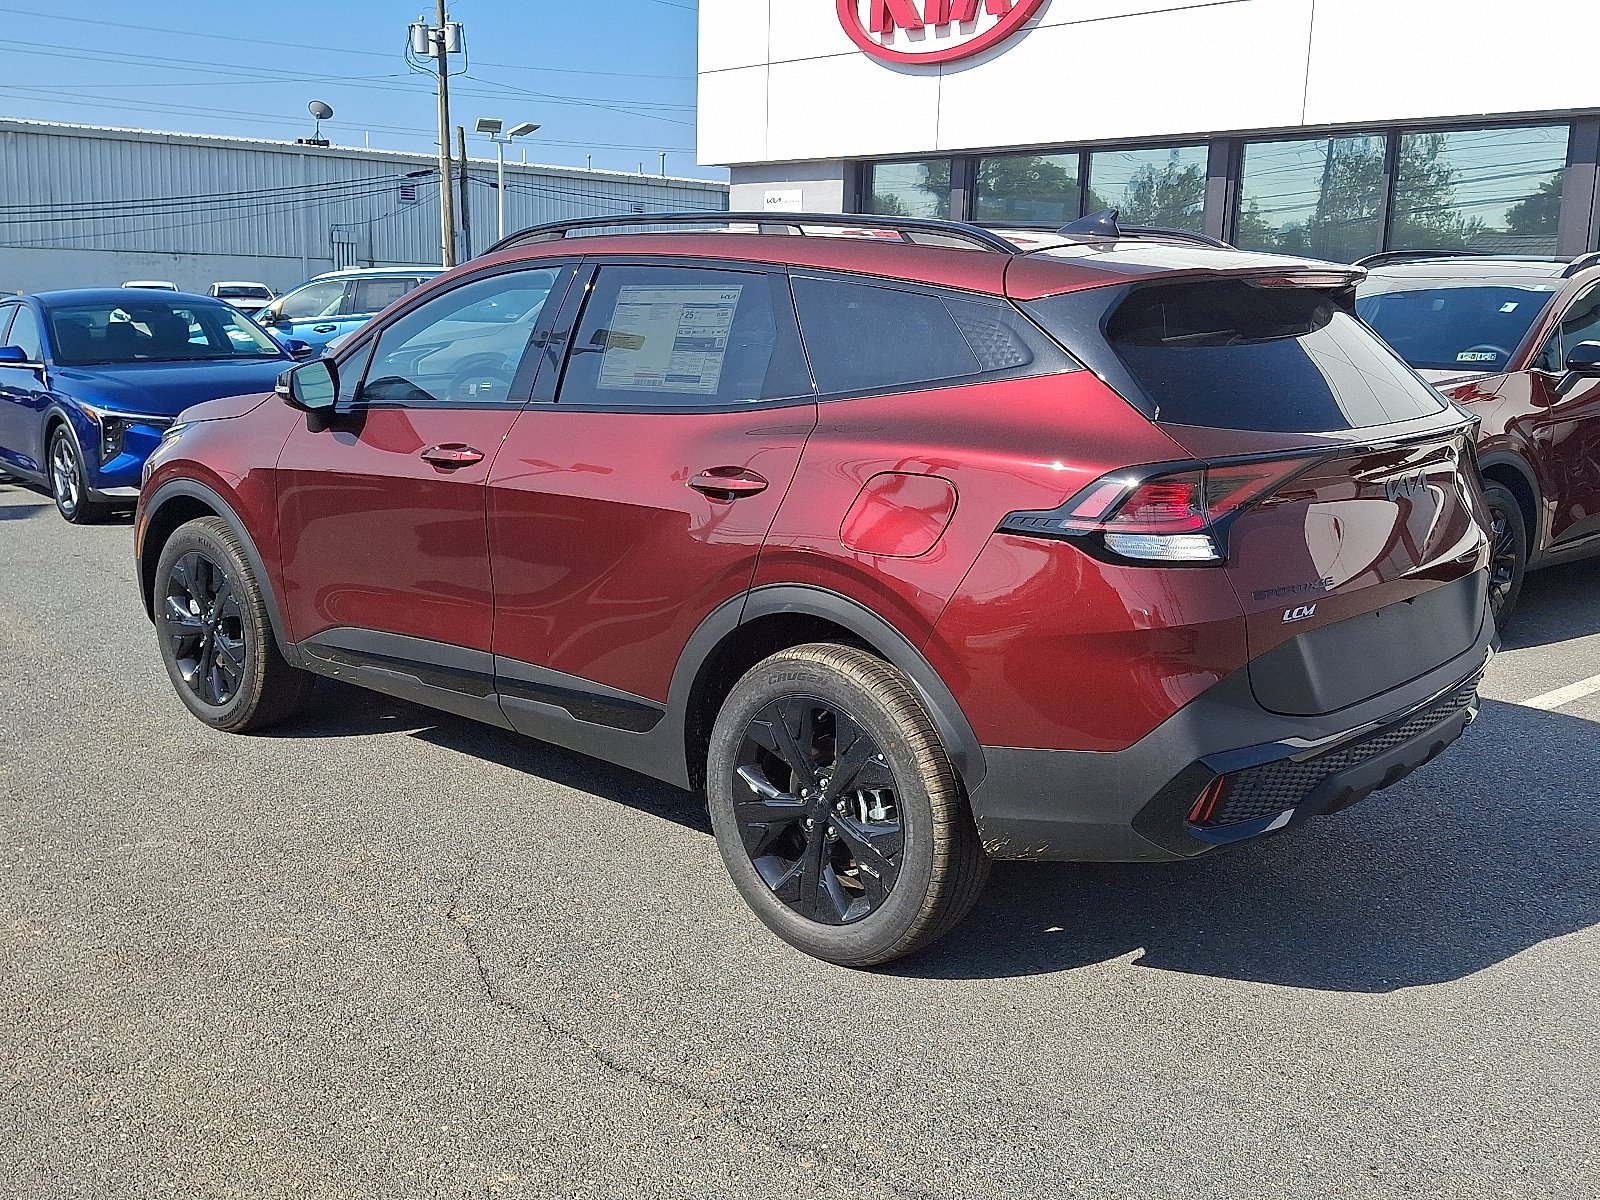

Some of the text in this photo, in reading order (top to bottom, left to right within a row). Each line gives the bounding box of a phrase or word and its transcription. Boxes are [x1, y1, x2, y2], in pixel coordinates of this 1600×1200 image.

[684, 310, 694, 319] 25
[1385, 469, 1428, 502] KIA
[1252, 576, 1335, 601] SPORTAGE
[1282, 604, 1316, 622] LCM
